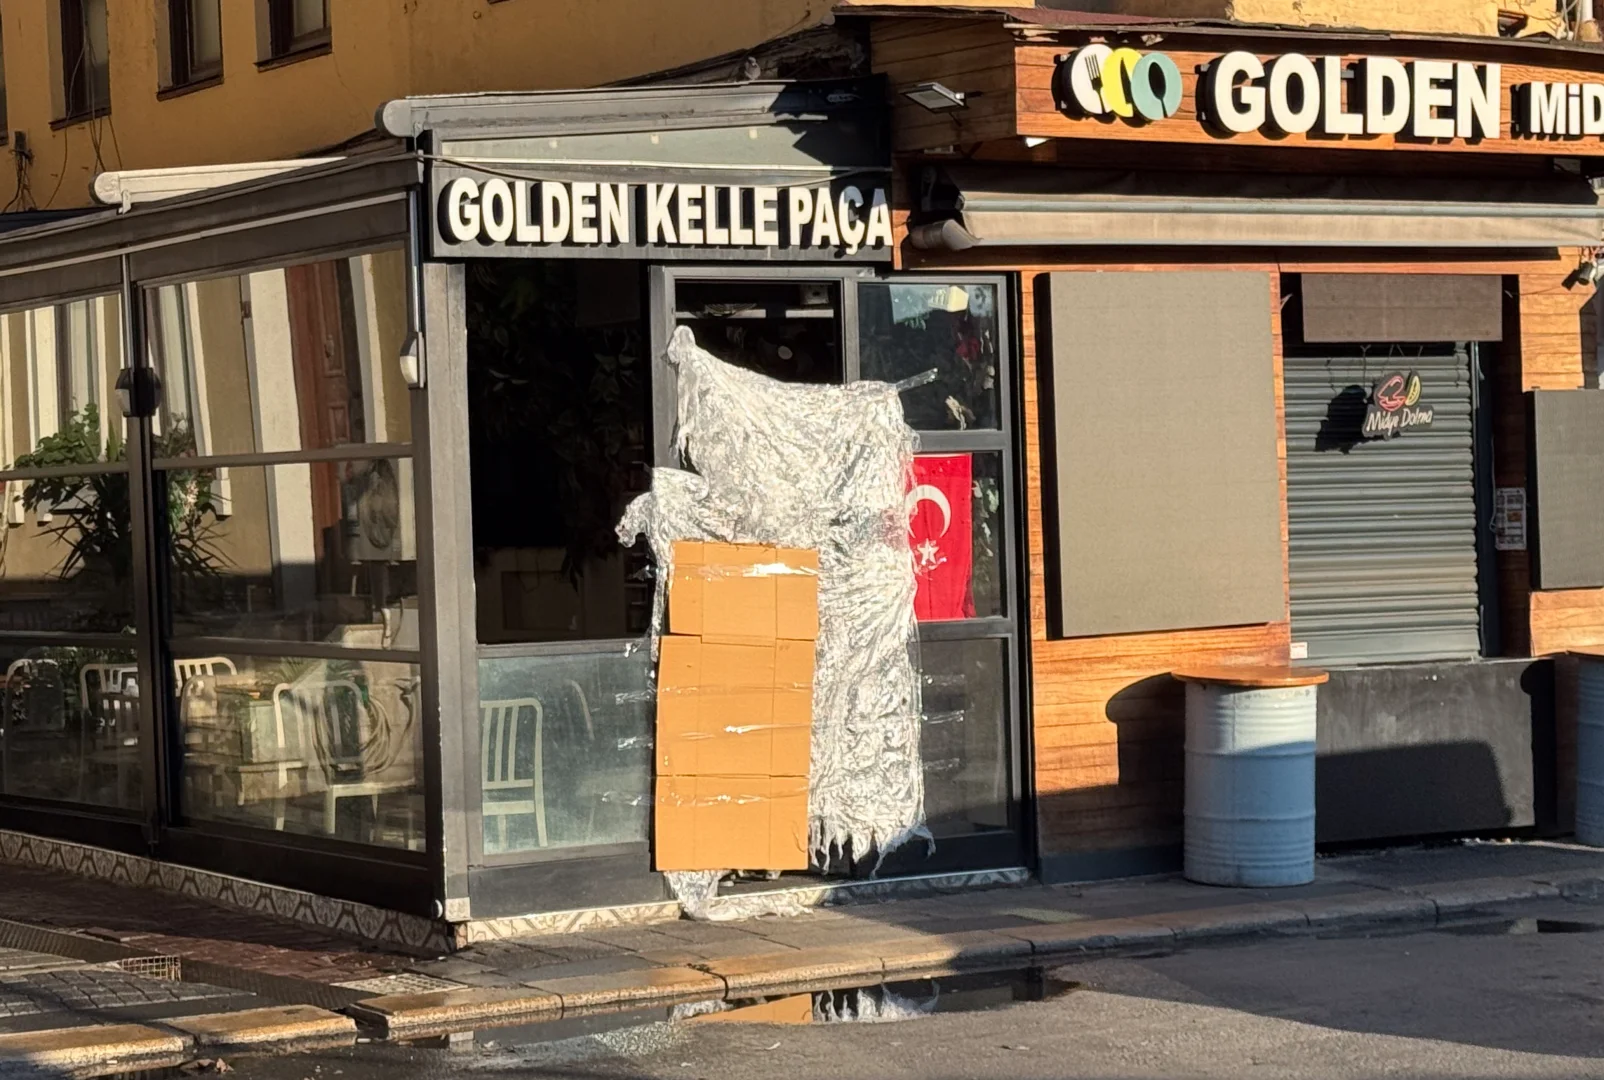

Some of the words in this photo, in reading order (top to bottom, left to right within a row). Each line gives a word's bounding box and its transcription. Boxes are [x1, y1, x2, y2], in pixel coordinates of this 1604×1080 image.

[1214, 51, 1501, 139] GOLDEN
[449, 177, 630, 244] GOLDEN
[645, 183, 780, 246] KELLE
[789, 186, 894, 255] PAÇA
[1400, 407, 1433, 428] Dolma
